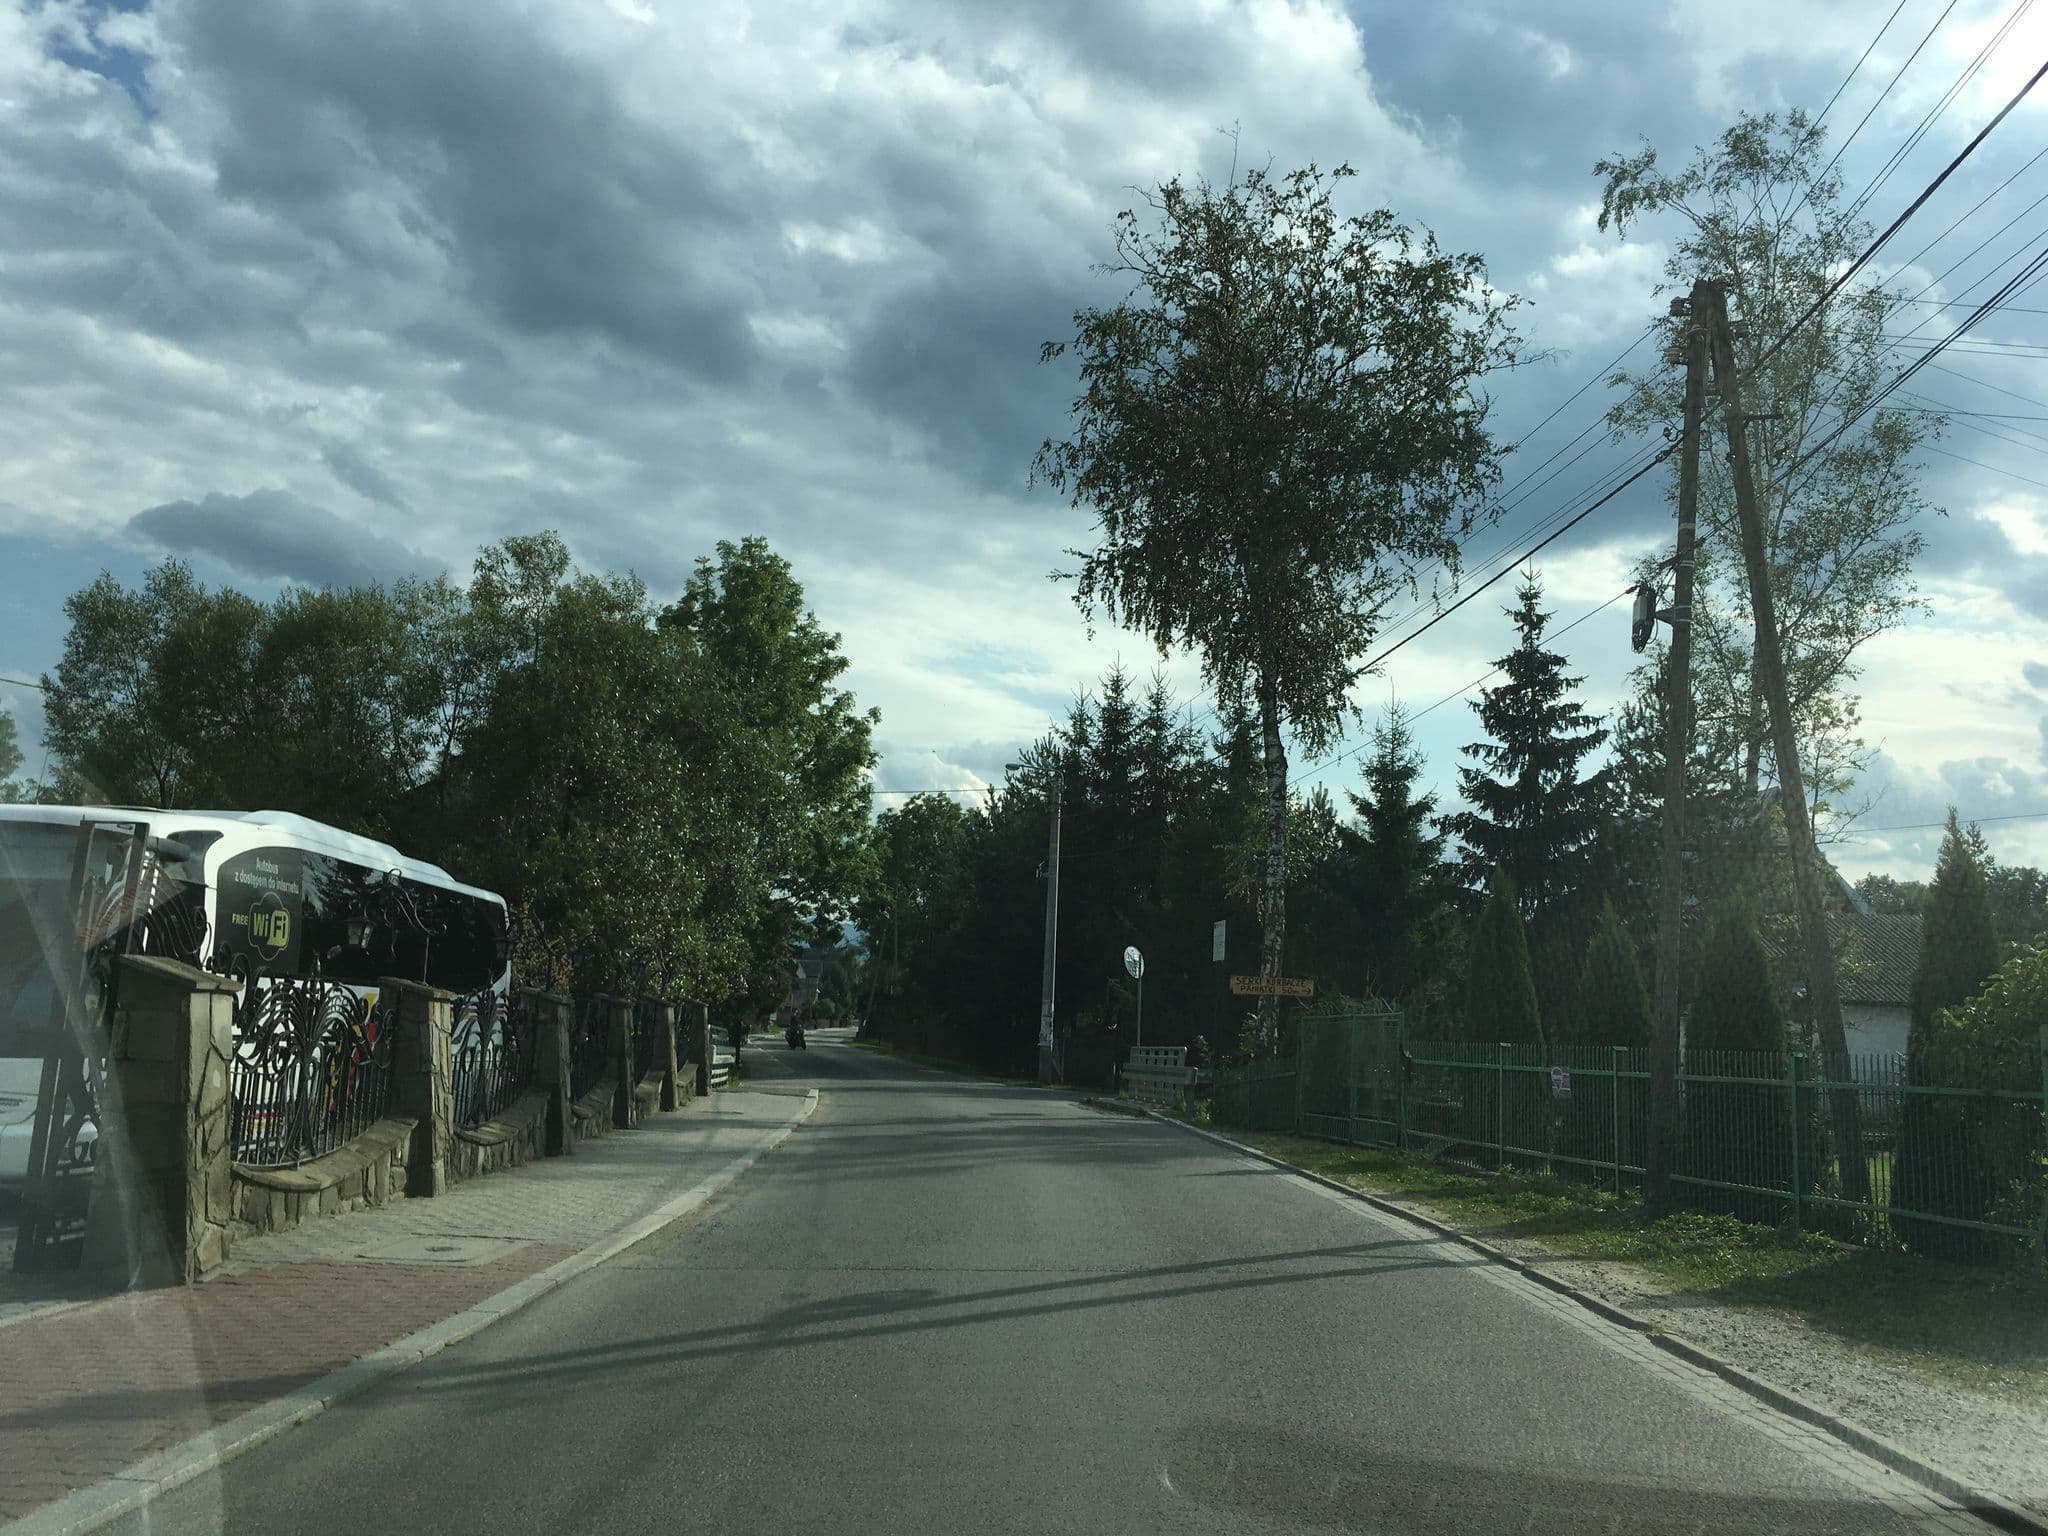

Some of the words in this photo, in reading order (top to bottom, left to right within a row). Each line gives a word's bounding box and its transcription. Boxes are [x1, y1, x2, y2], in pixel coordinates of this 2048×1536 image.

[256, 857, 279, 874] Autobus
[234, 872, 239, 882] z
[268, 876, 275, 889] do
[232, 913, 248, 925] FREE
[1236, 976, 1262, 985] SERKI
